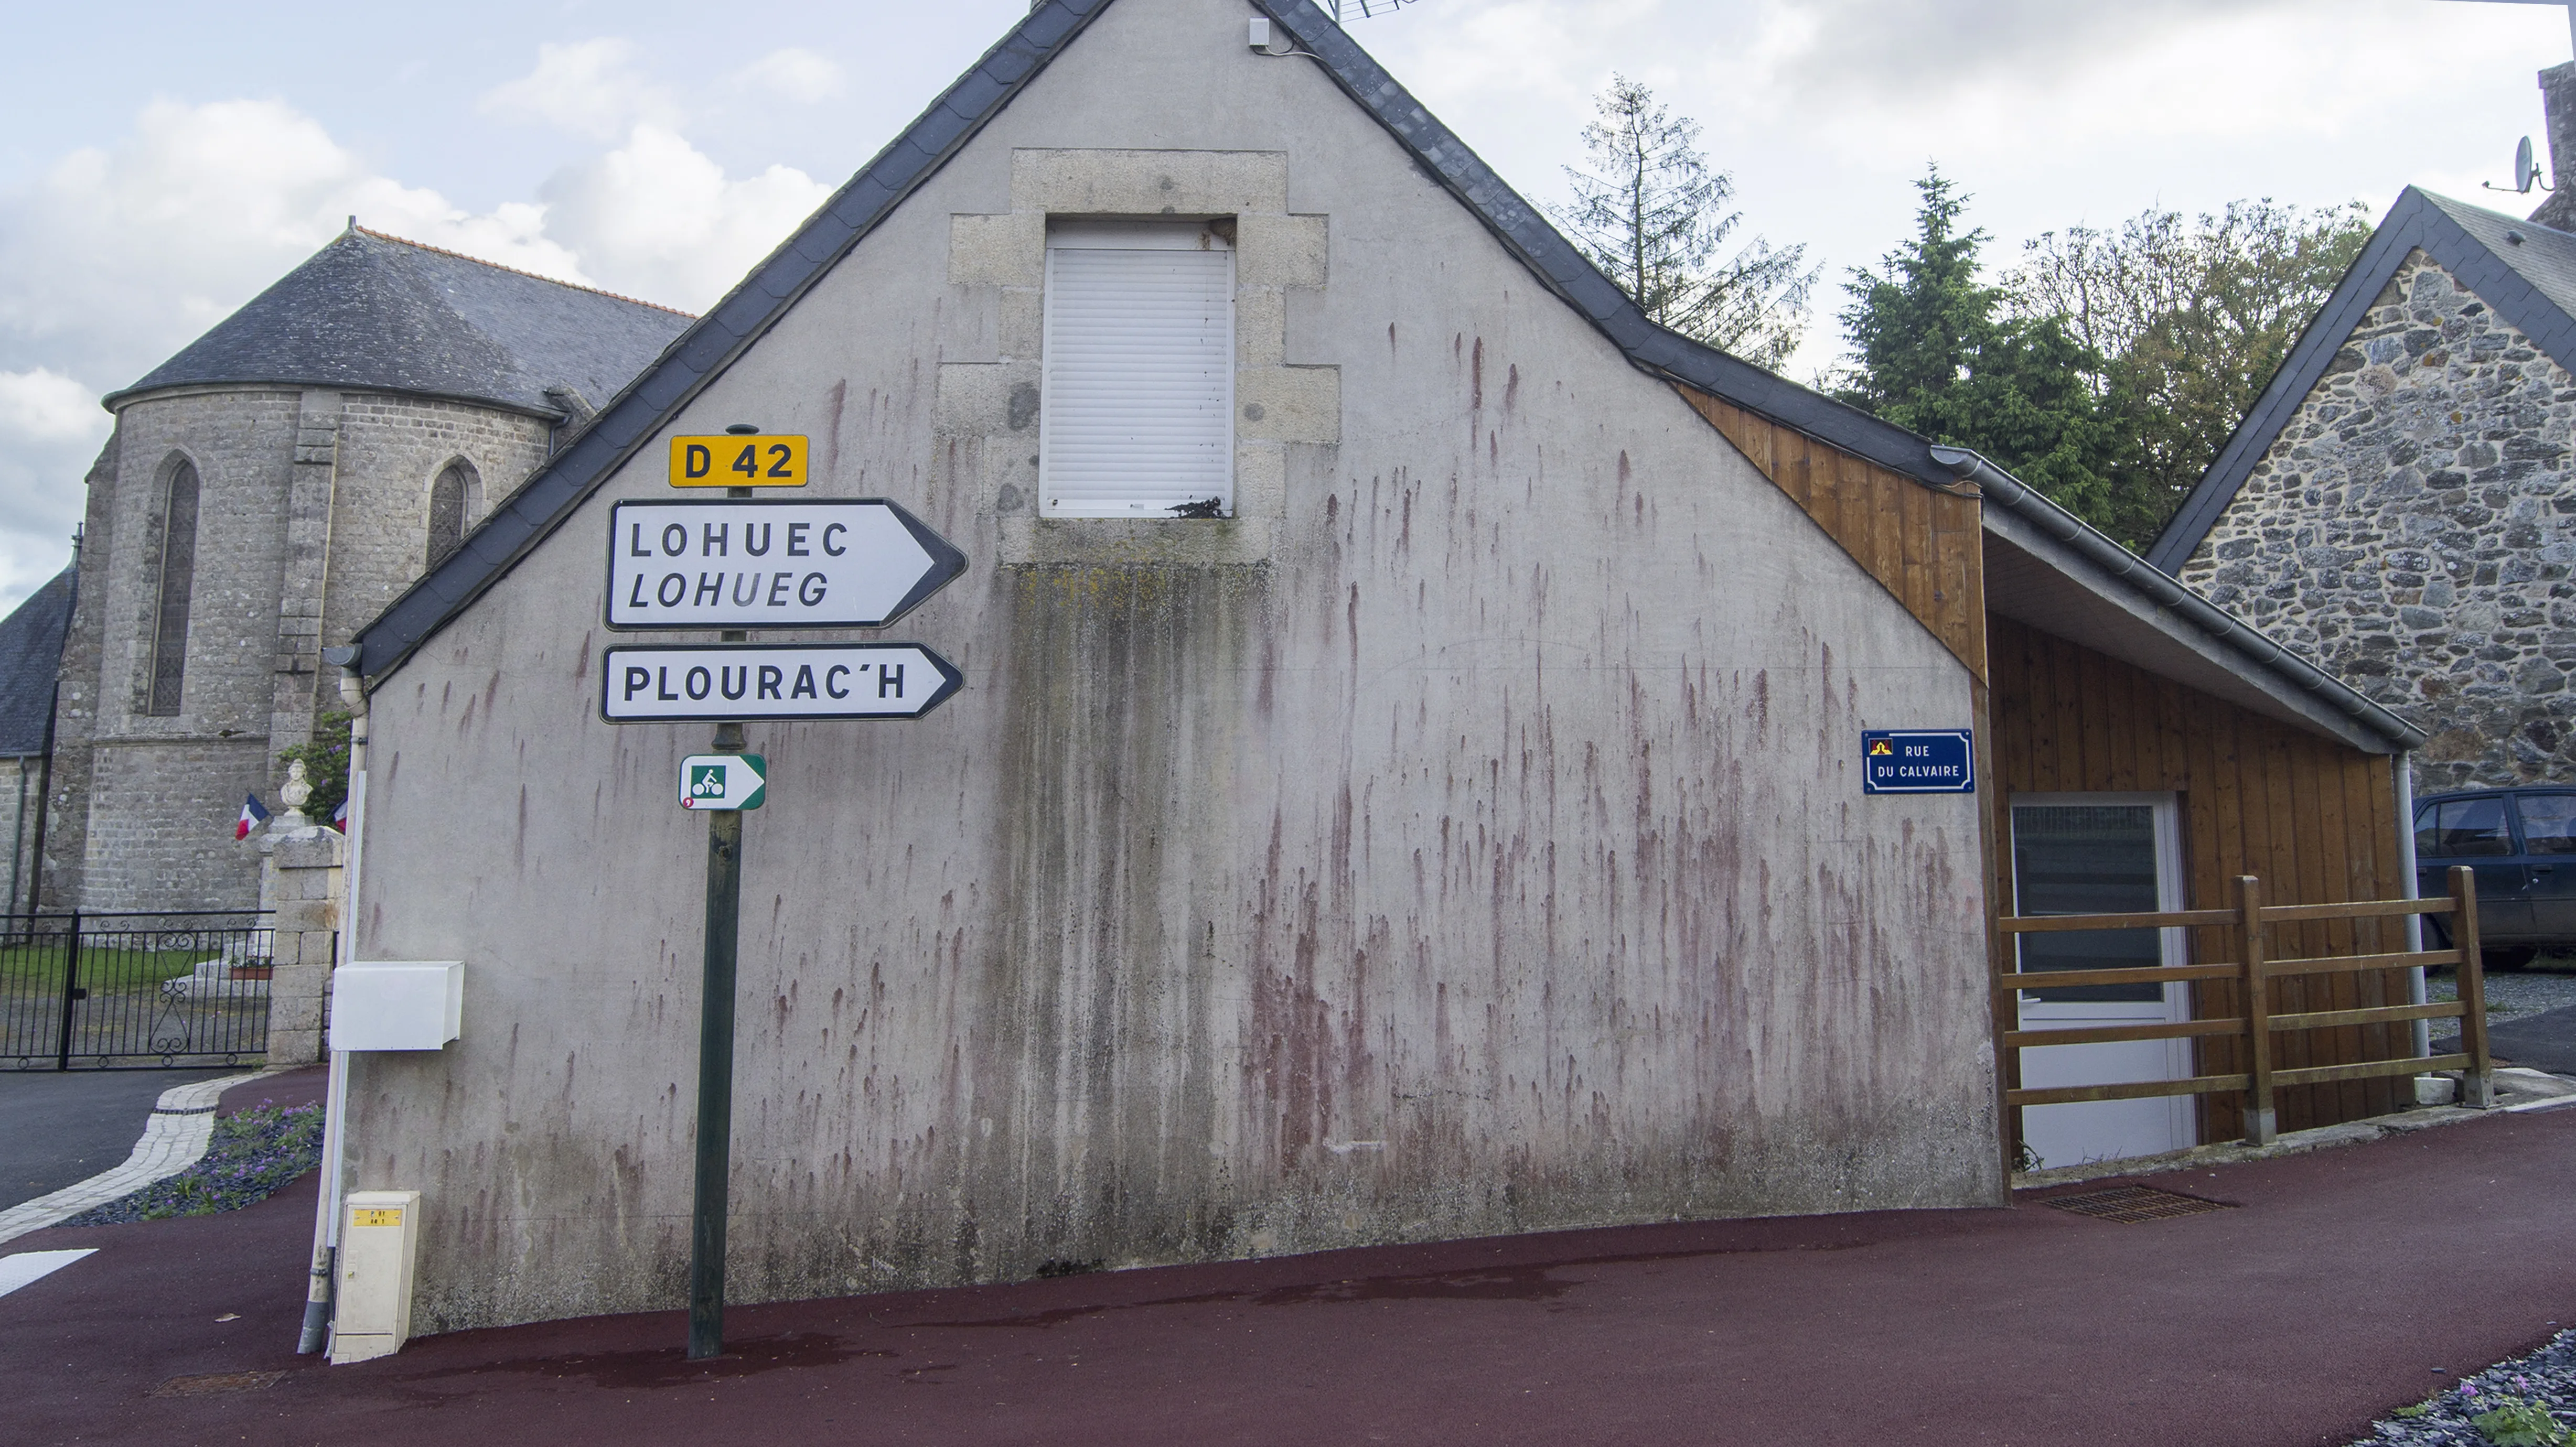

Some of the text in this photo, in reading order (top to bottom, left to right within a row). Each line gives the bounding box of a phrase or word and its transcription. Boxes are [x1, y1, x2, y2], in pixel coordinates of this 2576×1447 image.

[685, 444, 793, 478] D 42
[631, 523, 847, 557] LOHUEC
[629, 571, 828, 608] LOHUEG
[1905, 746, 1930, 757] RUE
[1877, 765, 1959, 778] DU CALVAIRE
